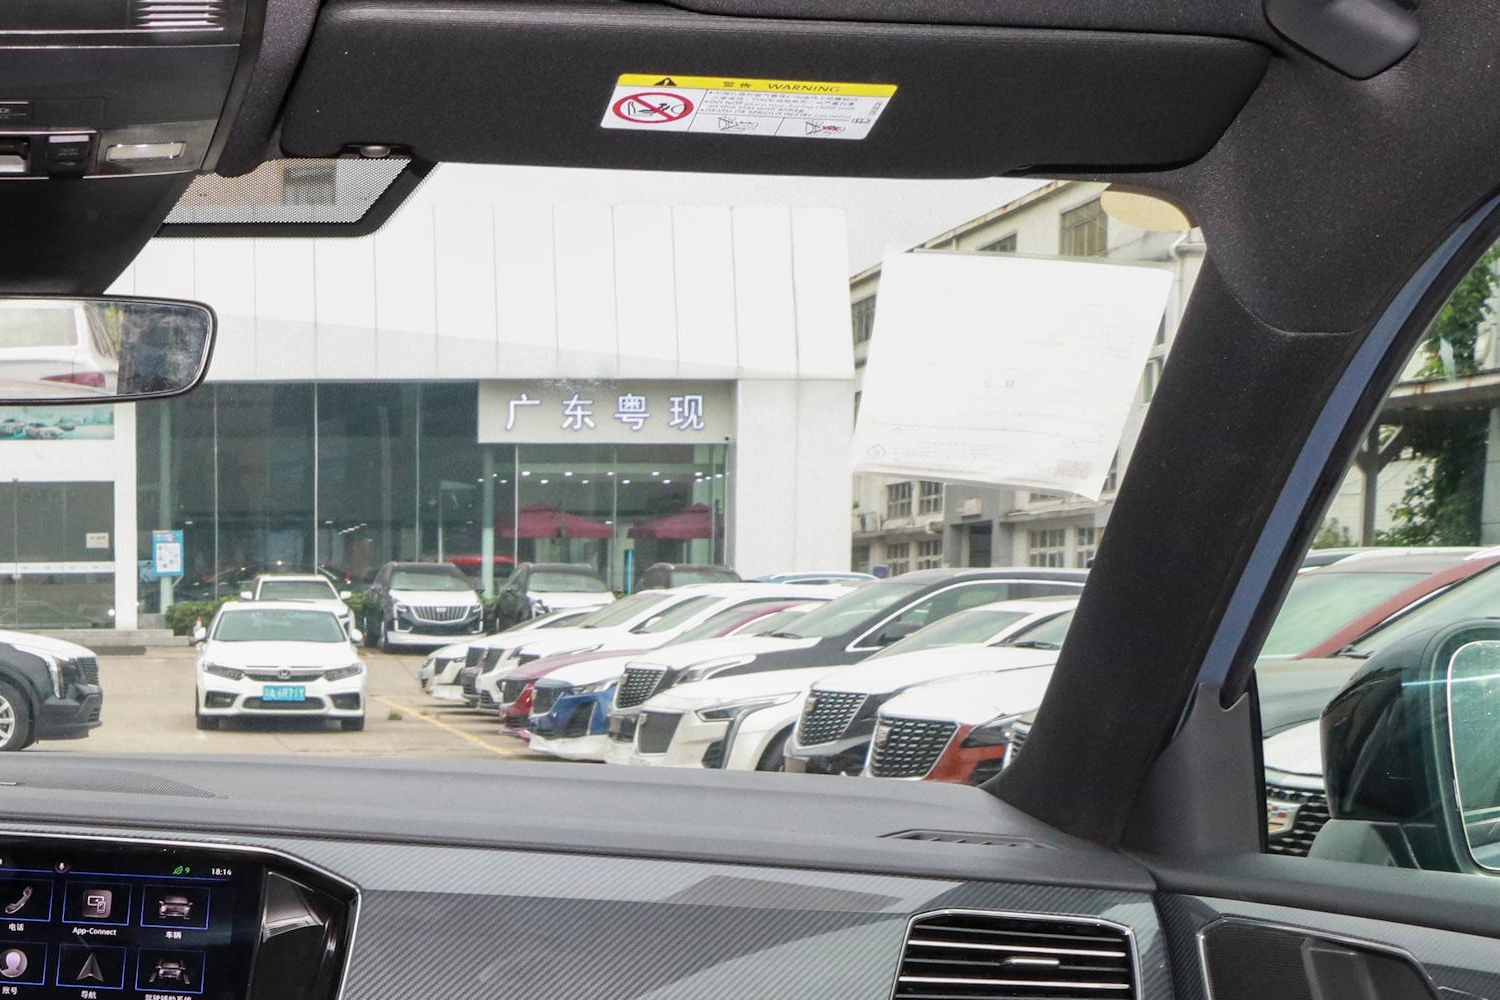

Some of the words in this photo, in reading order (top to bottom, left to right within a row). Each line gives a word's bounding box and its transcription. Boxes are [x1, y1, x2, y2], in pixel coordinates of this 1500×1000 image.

[767, 82, 840, 92] WARNING
[505, 393, 705, 431] 广东粤现
[185, 866, 191, 874] 9
[211, 868, 232, 876] 18:14
[8, 923, 24, 932] 电话
[72, 927, 117, 936] App-Connect
[81, 990, 97, 999] 导航
